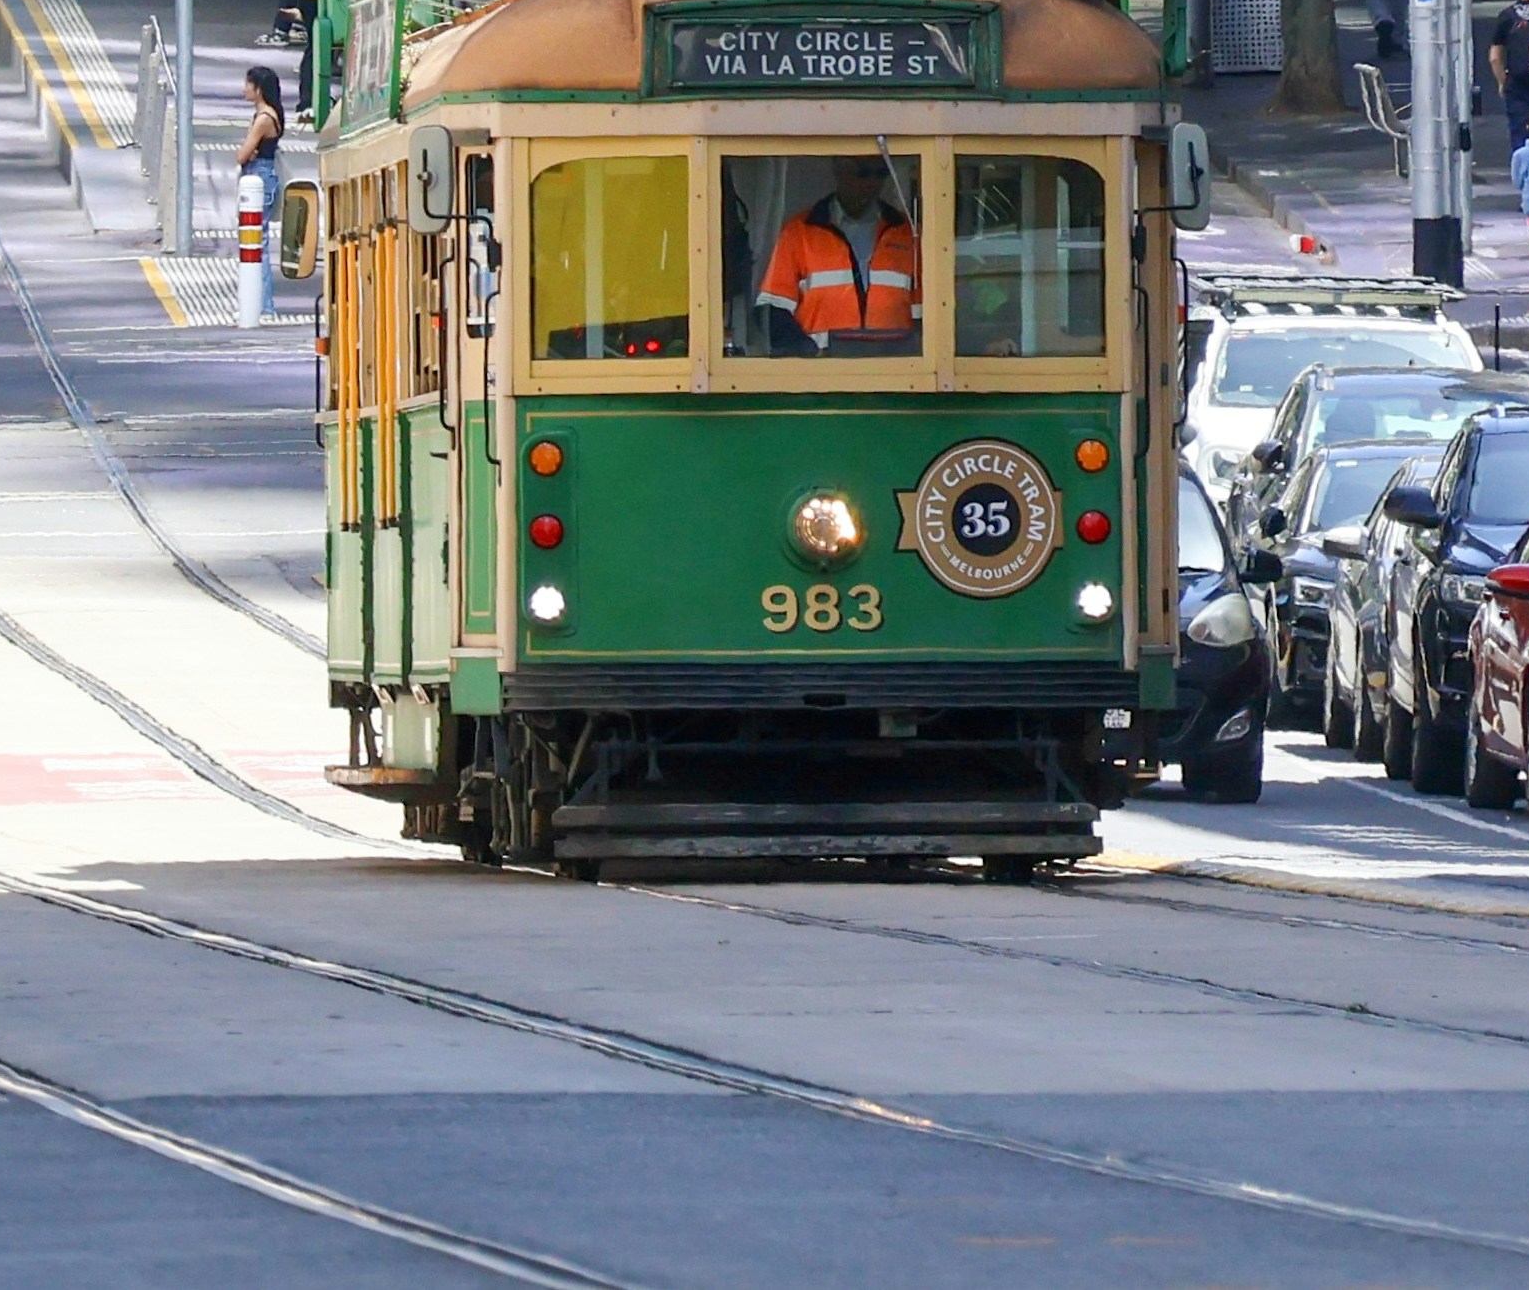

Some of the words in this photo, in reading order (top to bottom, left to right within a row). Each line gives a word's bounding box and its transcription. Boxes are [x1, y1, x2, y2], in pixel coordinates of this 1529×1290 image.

[719, 31, 780, 51] CITY
[795, 31, 895, 51] CIRCLE
[705, 55, 747, 75] VIA
[761, 55, 795, 75] LA
[804, 55, 894, 76] TROBE
[907, 56, 940, 75] ST
[925, 487, 948, 543] CITY
[942, 454, 1018, 488] CIRCLE
[1017, 471, 1047, 542] TRAM
[961, 499, 1011, 538] 35
[949, 555, 1027, 580] MELBOURNE
[761, 583, 884, 633] 983
